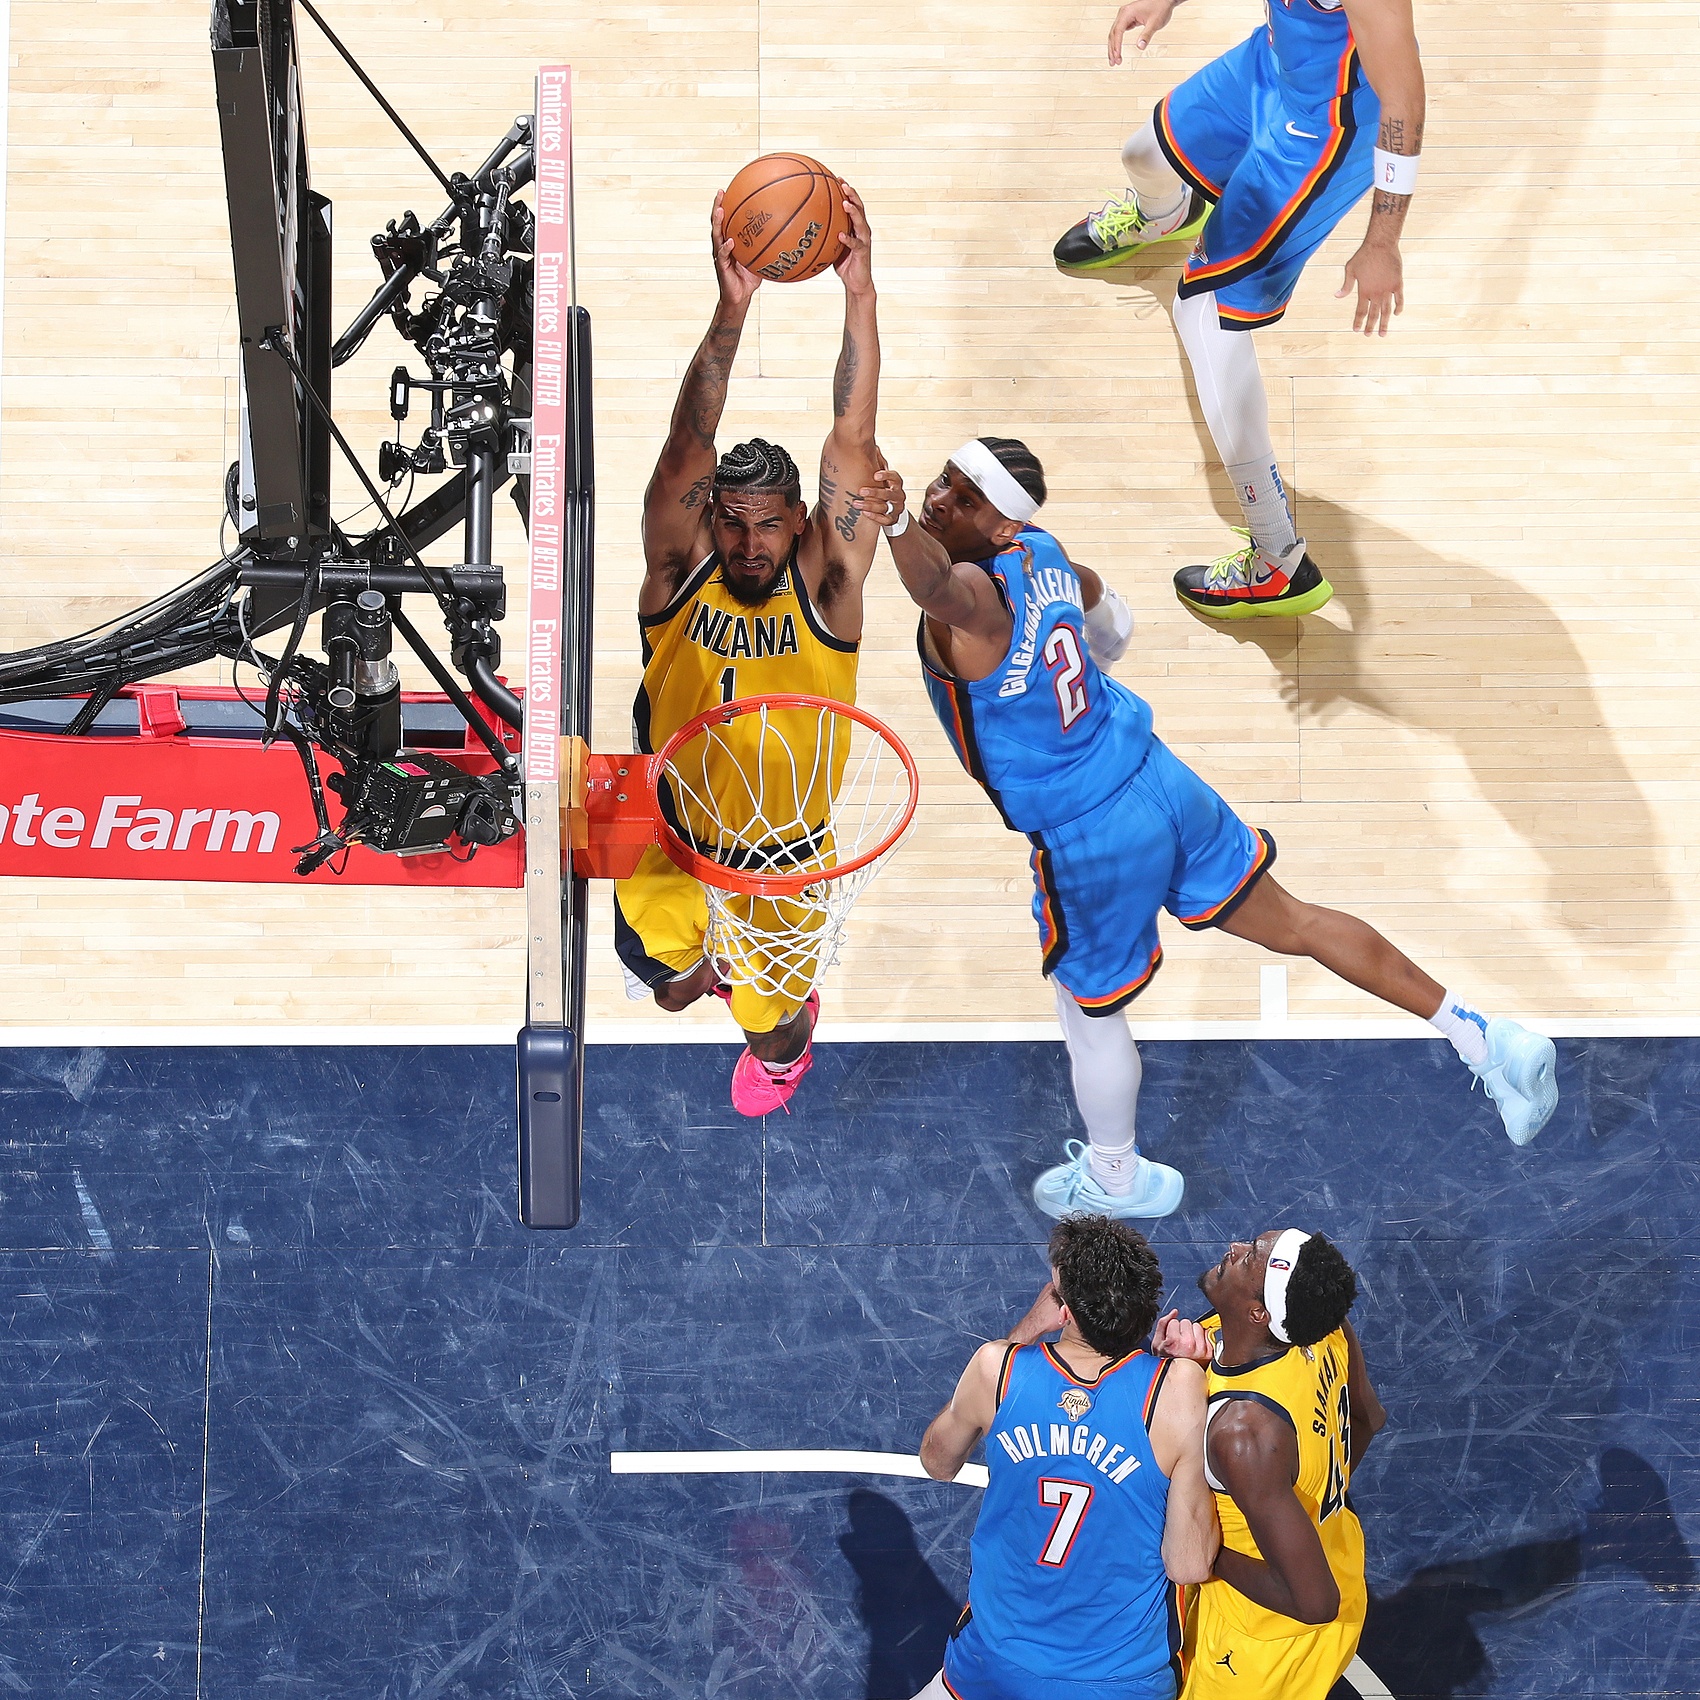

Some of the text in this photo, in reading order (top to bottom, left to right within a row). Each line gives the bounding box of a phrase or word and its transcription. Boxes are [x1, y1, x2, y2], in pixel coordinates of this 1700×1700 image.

[540, 71, 567, 224] Emirates FLY BETTER
[756, 220, 823, 279] Wilson
[536, 251, 563, 407] Emirates FLY BETTER
[533, 433, 560, 591] Emirates FLY BETTER
[529, 618, 557, 777] Emirates FLY BETTER
[718, 667, 737, 726] 1
[1041, 622, 1091, 734] 2
[1057, 1391, 1090, 1408] Finals
[996, 1423, 1142, 1485] HOLMGREN
[1036, 1476, 1095, 1569] 7
